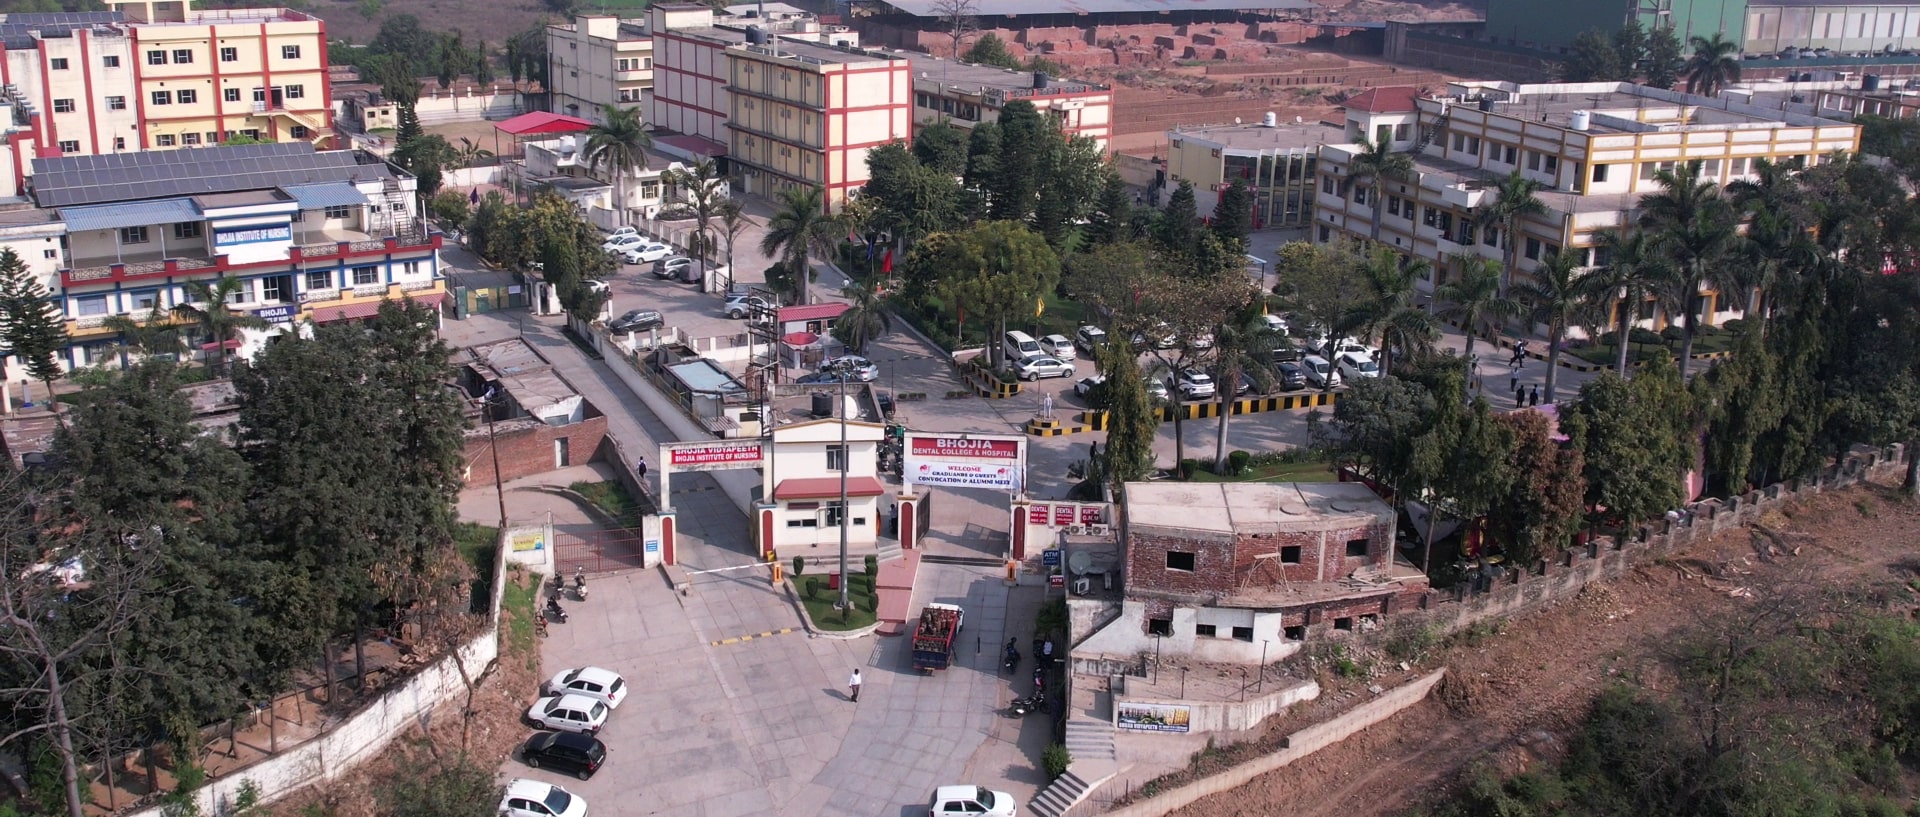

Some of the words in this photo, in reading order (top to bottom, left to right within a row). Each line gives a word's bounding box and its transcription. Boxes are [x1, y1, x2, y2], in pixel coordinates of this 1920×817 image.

[235, 231, 260, 241] INSTITUTE
[261, 230, 267, 239] OF
[268, 228, 289, 238] NURSING
[260, 308, 287, 317] BHOJIA
[937, 439, 992, 448] BHOJIA
[982, 449, 1015, 457] HOSPITAL
[1031, 505, 1047, 513] DENTAL
